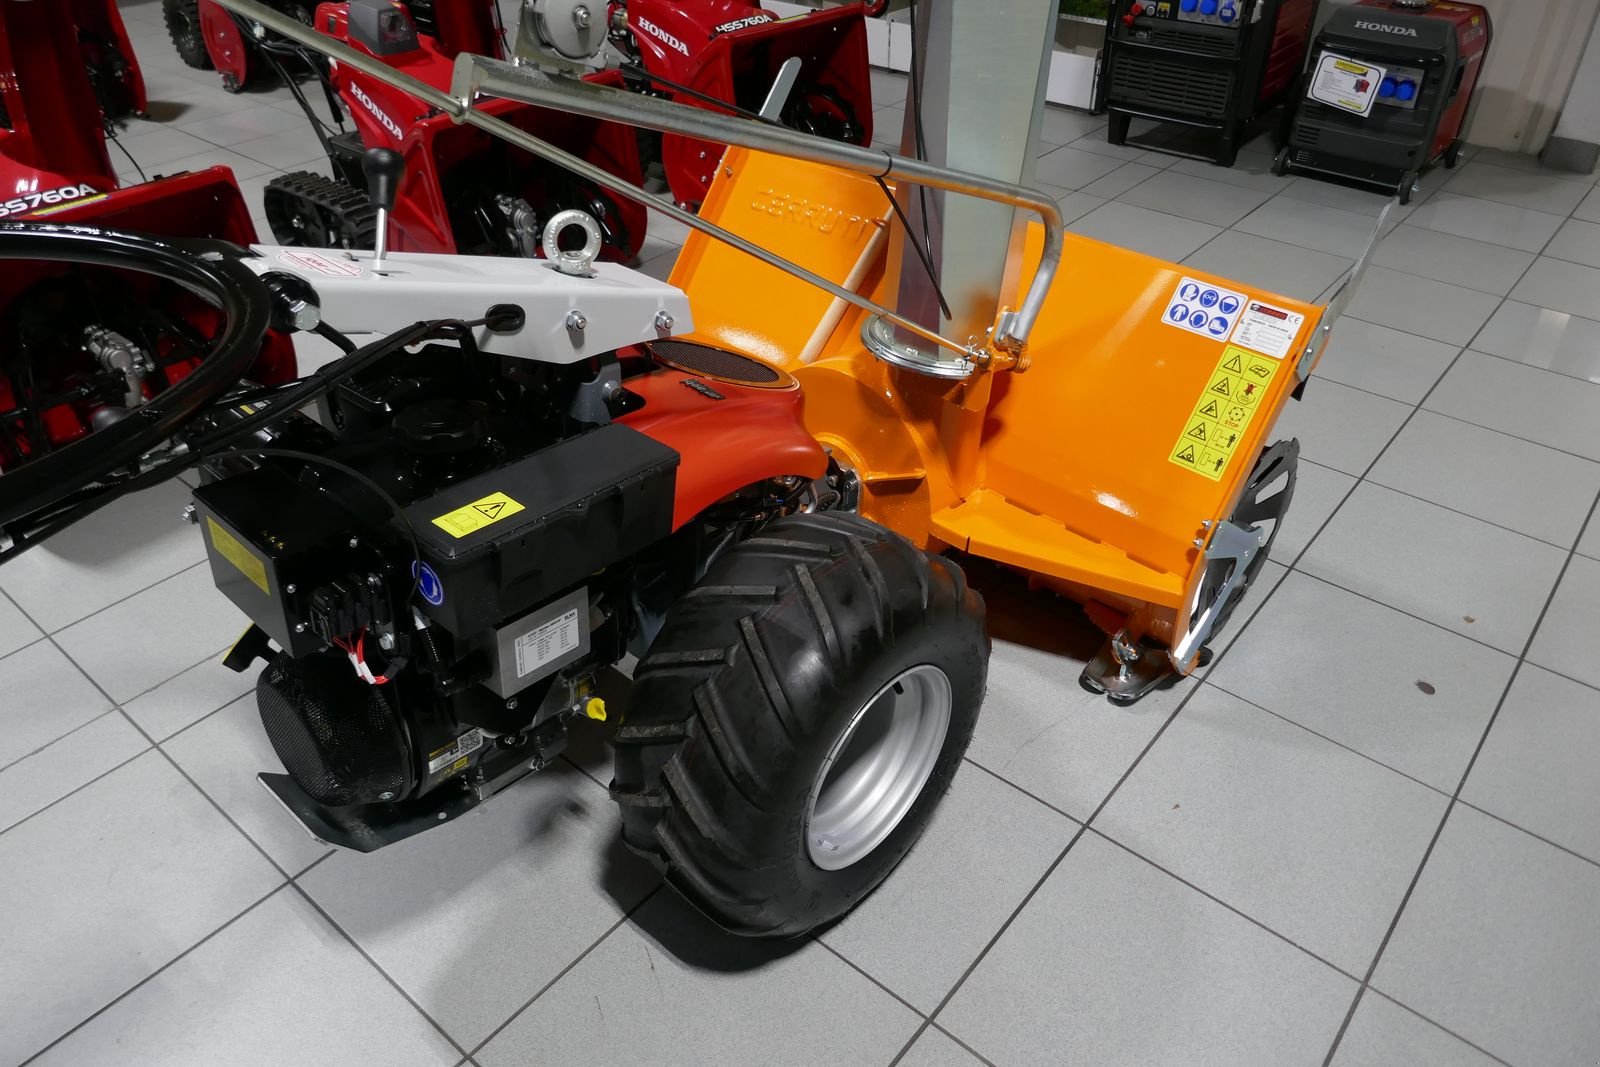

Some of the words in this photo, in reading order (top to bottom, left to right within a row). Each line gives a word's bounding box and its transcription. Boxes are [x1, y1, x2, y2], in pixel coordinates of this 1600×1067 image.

[638, 16, 689, 57] HONDA
[715, 14, 773, 33] HSS760A
[1354, 20, 1417, 37] HONDA
[351, 81, 403, 141] HONDA
[751, 189, 869, 242] CERRUTI
[1223, 419, 1239, 428] STOP
